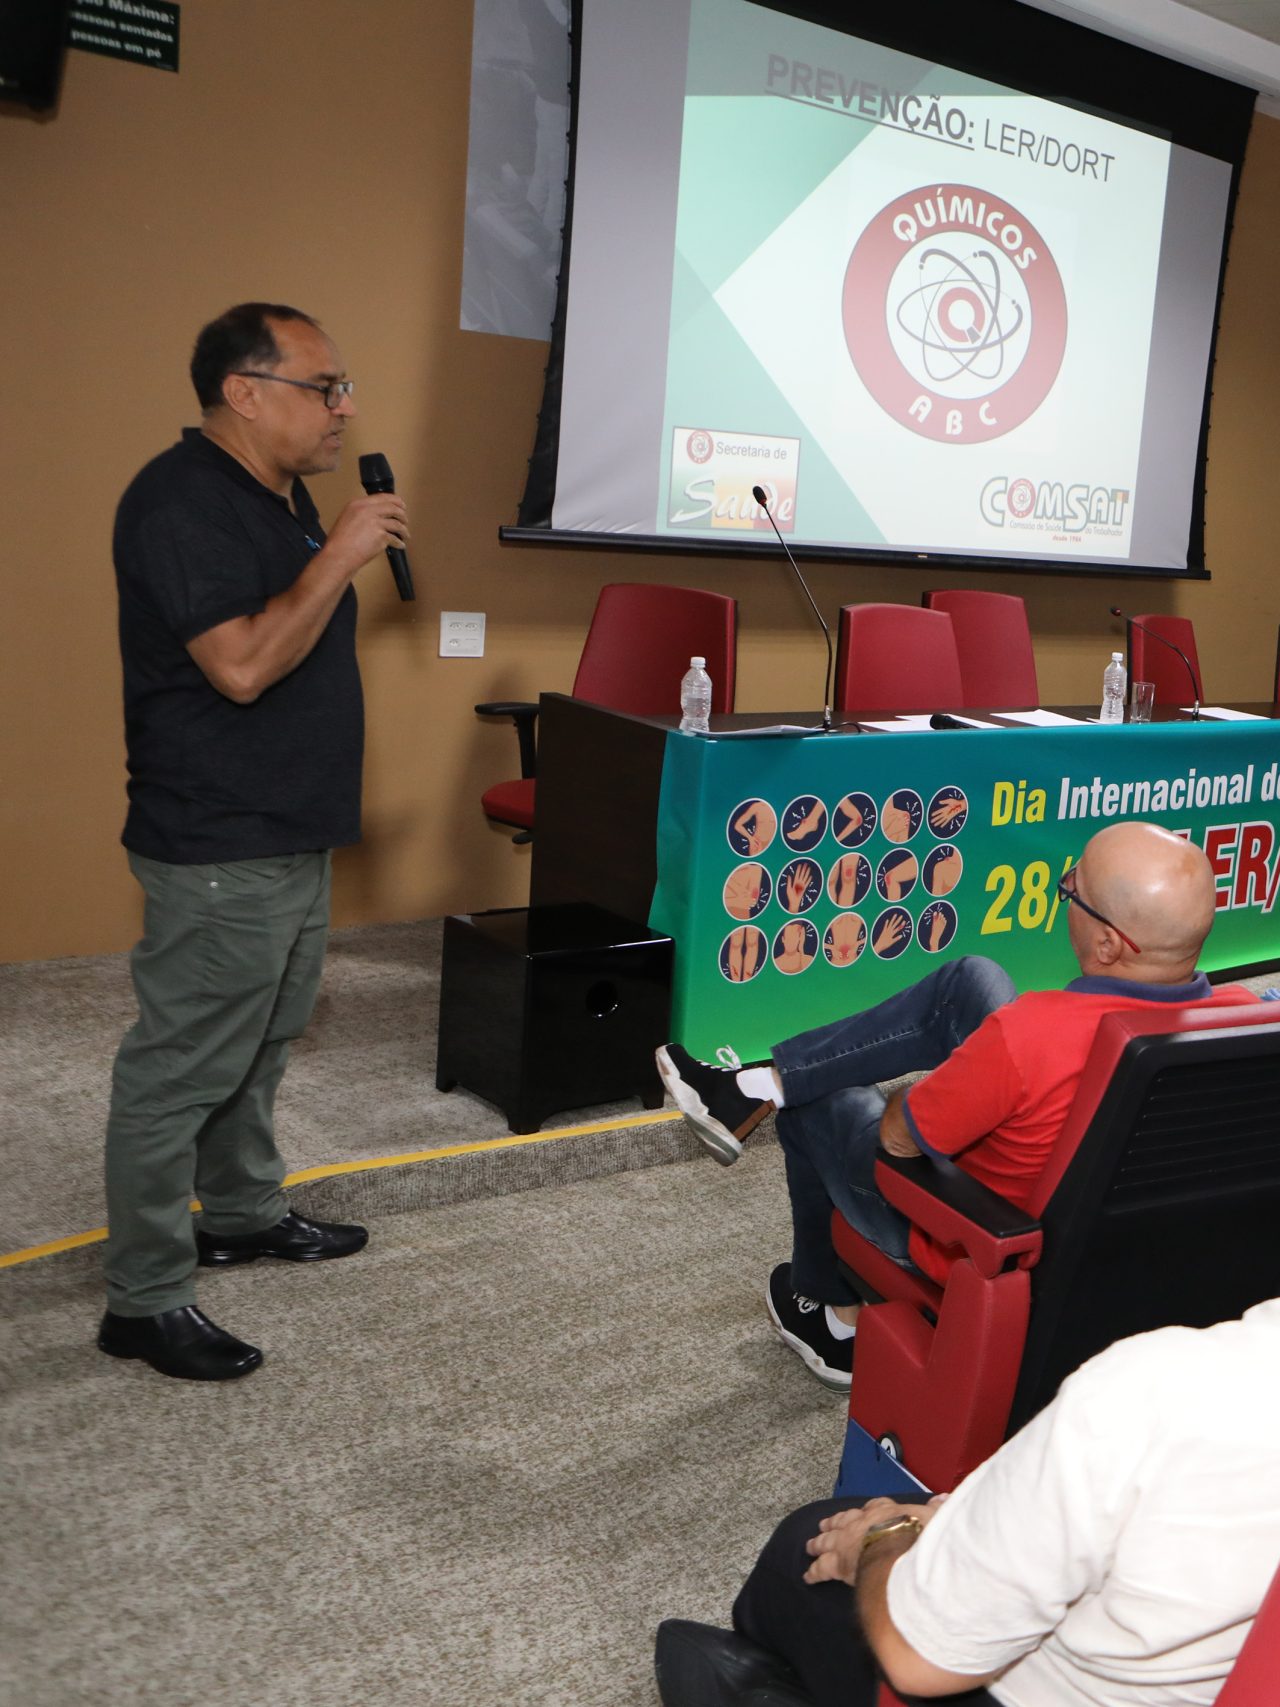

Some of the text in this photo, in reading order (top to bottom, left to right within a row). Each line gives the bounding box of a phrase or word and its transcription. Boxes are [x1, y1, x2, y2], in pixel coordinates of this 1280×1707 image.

[71, 30, 162, 59] pessoas em pé
[119, 22, 174, 43] sentadas
[766, 54, 1115, 183] PREVENÇÃO: LER/DORT
[892, 187, 1038, 270] QUÍMICOS
[715, 441, 771, 459] Secretaria
[773, 447, 788, 460] de
[991, 779, 1047, 827] Dia
[1056, 764, 1255, 821] Internacional
